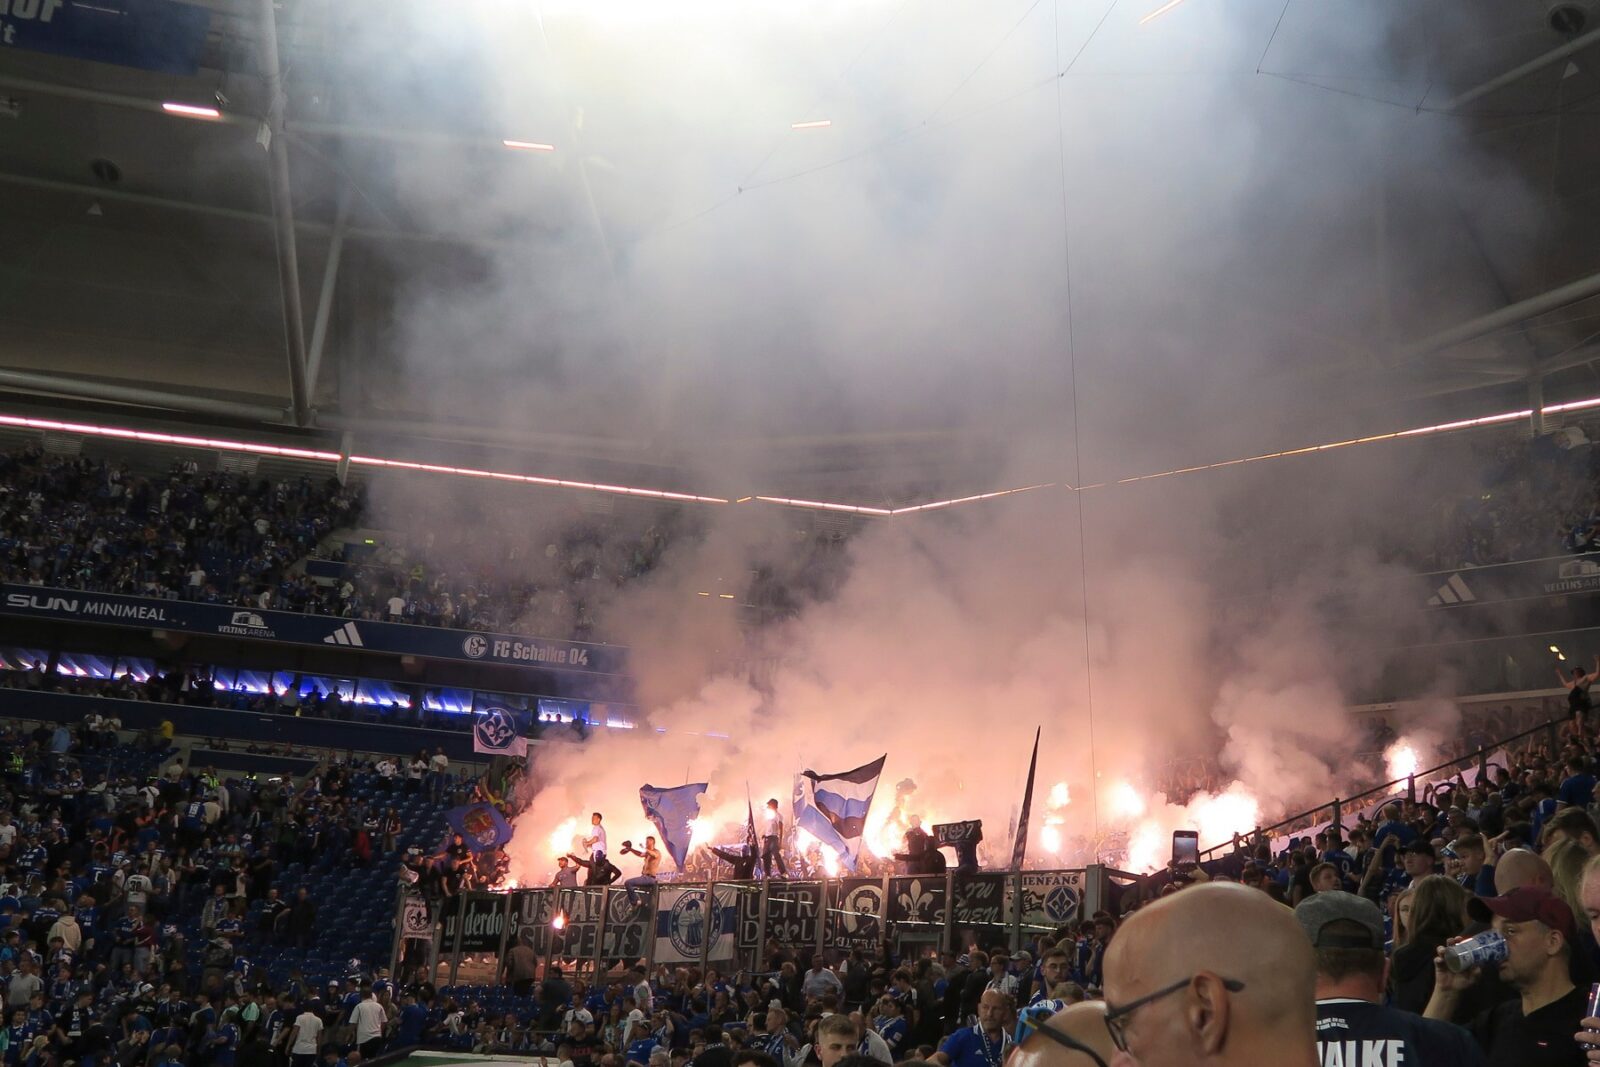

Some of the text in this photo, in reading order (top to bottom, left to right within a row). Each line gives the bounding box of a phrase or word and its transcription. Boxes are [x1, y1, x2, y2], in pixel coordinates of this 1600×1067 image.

[7, 594, 166, 621] SUN MINIMEAL
[218, 625, 275, 637] VELTINS ARENA
[493, 640, 588, 666] FC Schalke 04
[445, 901, 518, 937] uderdos
